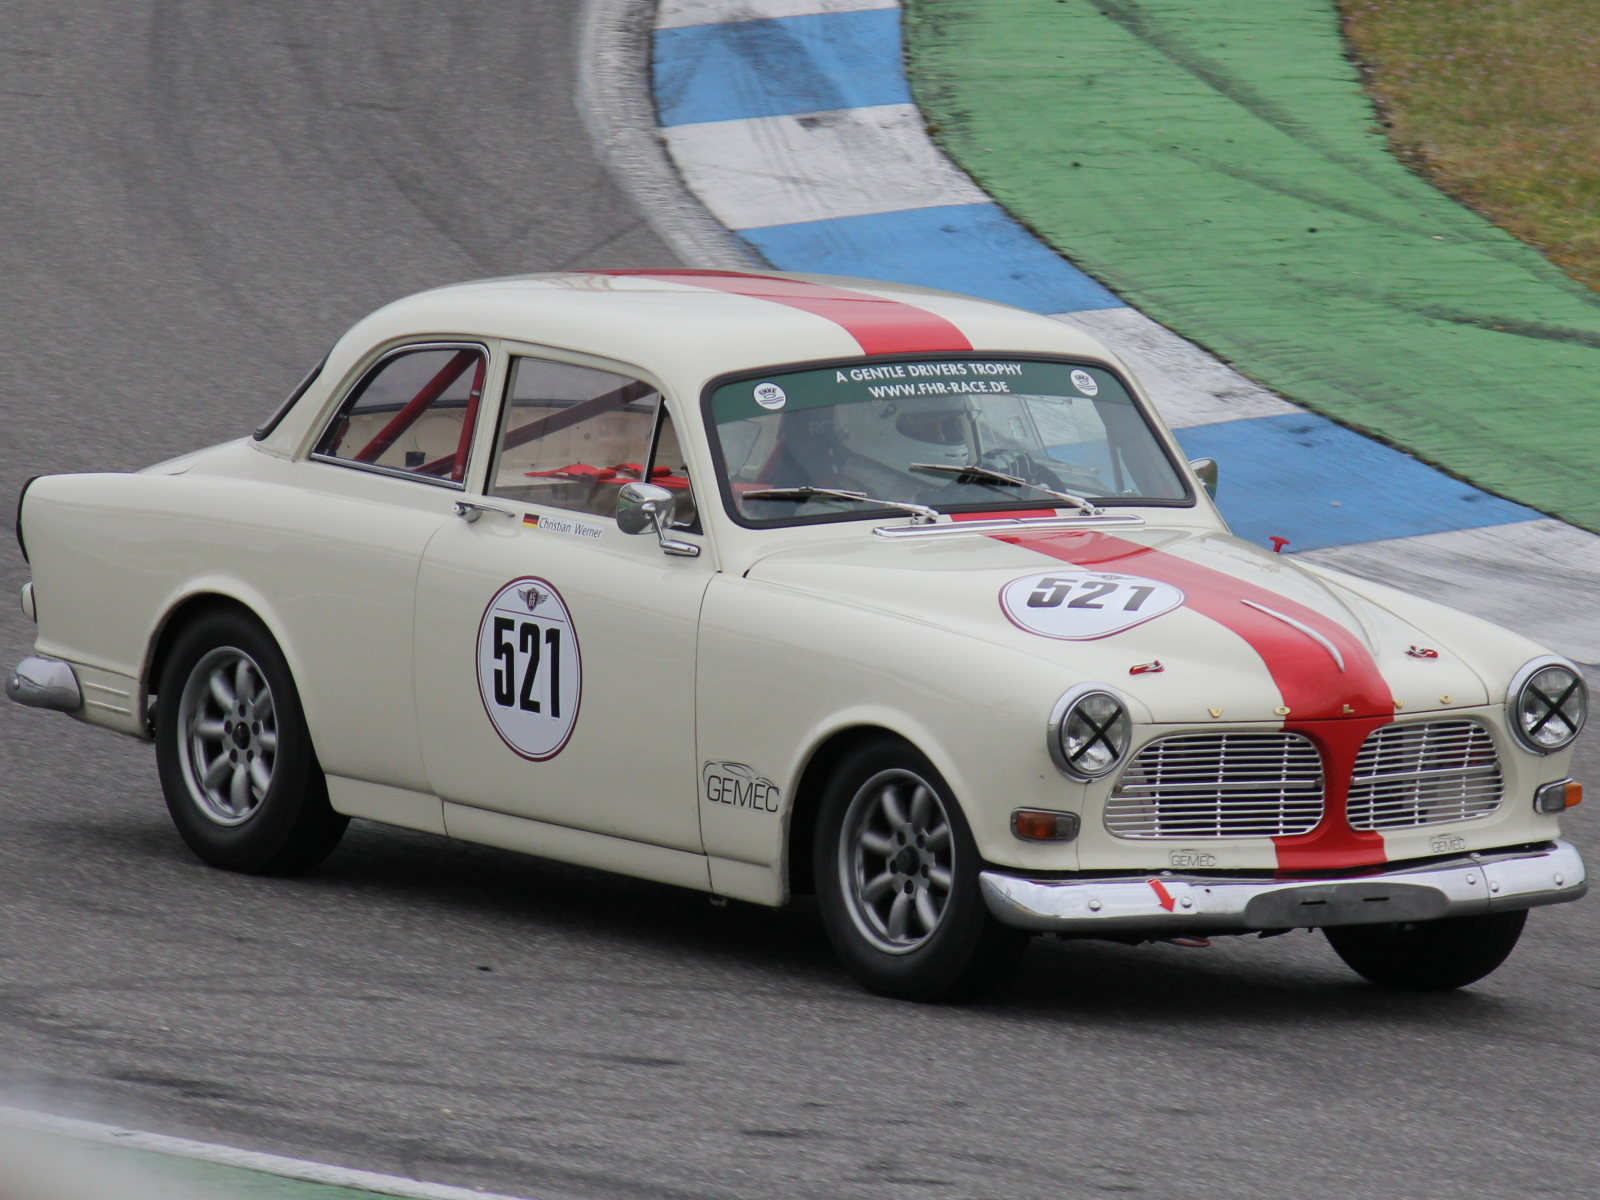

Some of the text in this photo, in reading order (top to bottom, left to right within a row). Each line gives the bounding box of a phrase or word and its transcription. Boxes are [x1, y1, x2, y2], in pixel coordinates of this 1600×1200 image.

[836, 363, 1022, 383] A GENTLE DRIVERS TROPHY
[868, 381, 1010, 398] WWW.FHR-RACE.DE
[539, 517, 602, 538] Christian Werner
[1026, 577, 1156, 611] 521
[494, 616, 560, 718] 521
[707, 775, 779, 812] GEMEC
[1433, 838, 1465, 853] GEMEC
[1171, 854, 1216, 867] GEMEC
